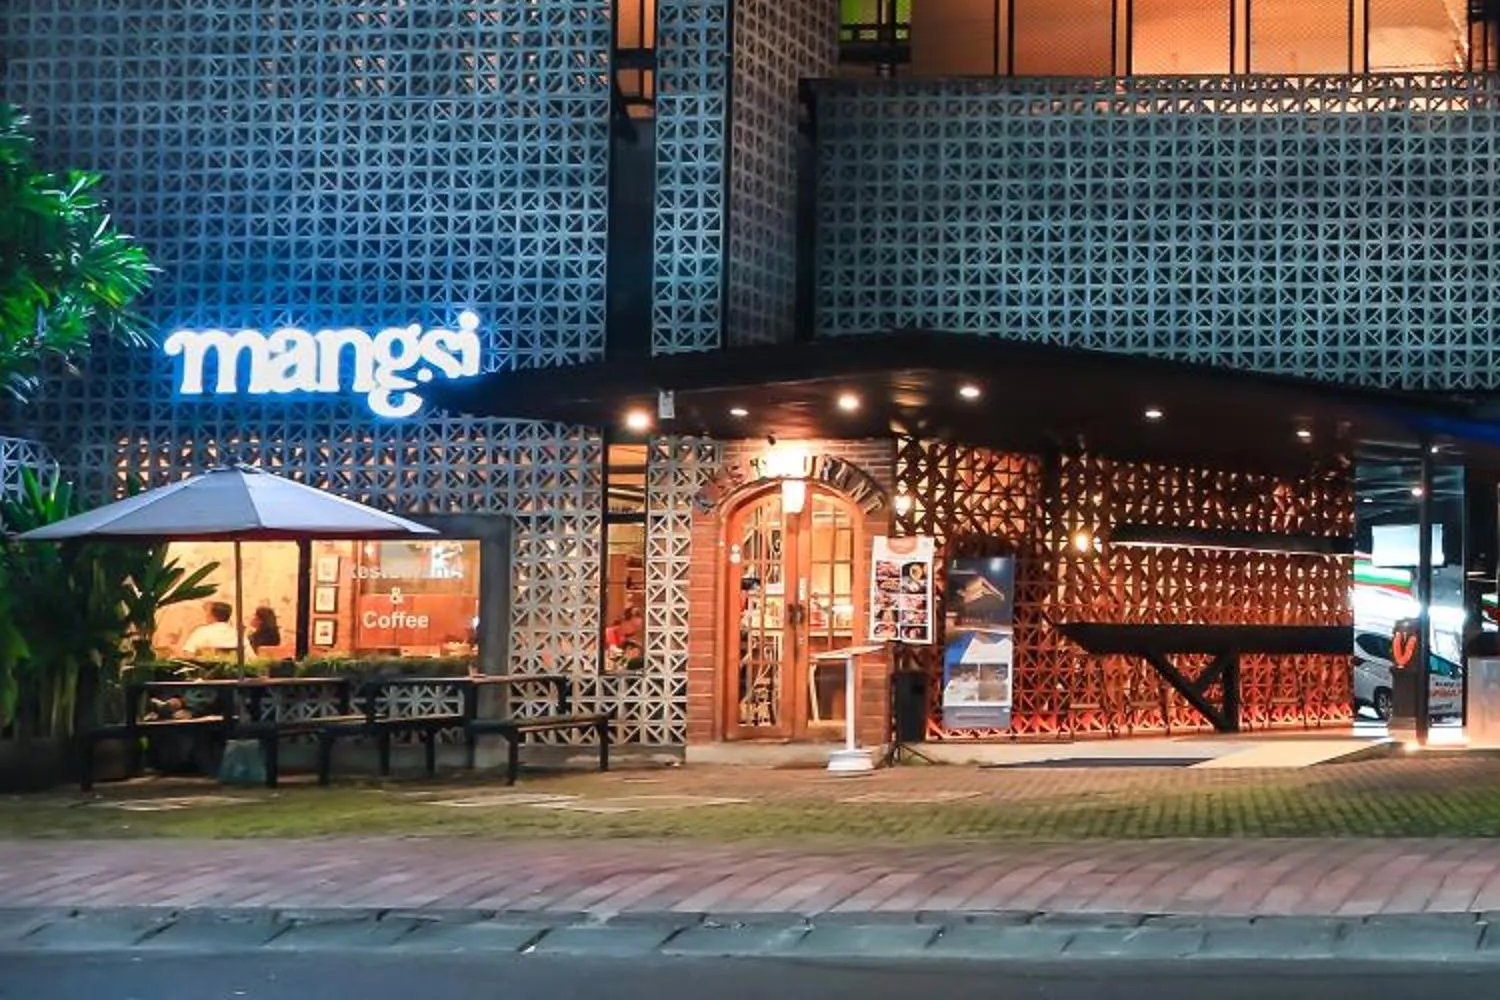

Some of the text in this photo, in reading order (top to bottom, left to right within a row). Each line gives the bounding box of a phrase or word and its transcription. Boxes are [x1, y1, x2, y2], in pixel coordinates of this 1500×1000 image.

[163, 311, 480, 418] mangsi
[389, 586, 404, 605] &
[362, 610, 430, 629] Coffee
